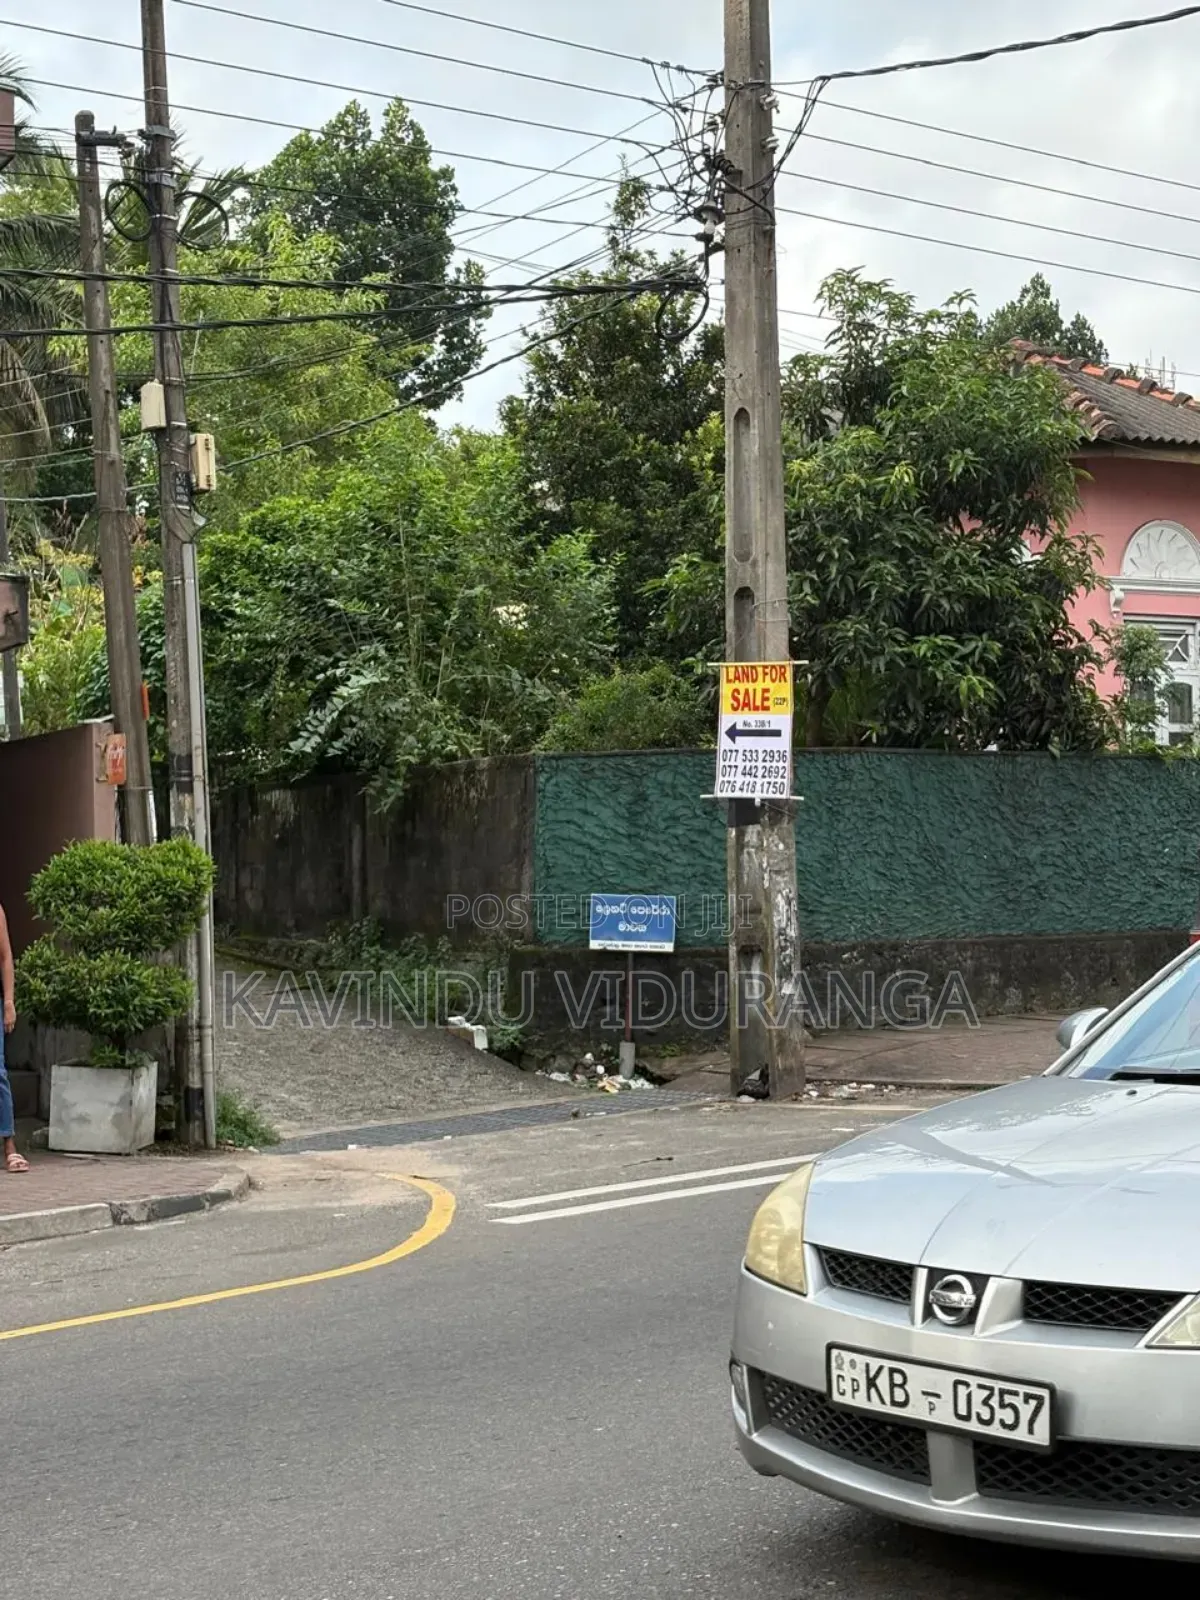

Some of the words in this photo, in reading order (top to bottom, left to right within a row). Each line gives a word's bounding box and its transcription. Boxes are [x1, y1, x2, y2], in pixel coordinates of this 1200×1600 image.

[725, 664, 759, 684] LAND
[762, 664, 787, 683] FOR
[730, 688, 770, 711] SALE
[722, 749, 739, 762] 077
[742, 749, 759, 762] 533
[762, 750, 787, 763] 2936
[721, 765, 738, 778] 077
[740, 765, 758, 778] 442
[761, 765, 786, 779] 2692
[719, 780, 736, 793] 076
[738, 780, 757, 794] 418
[760, 781, 785, 795] 1750
[865, 1362, 911, 1409] KB
[952, 1379, 1045, 1436] 0357
